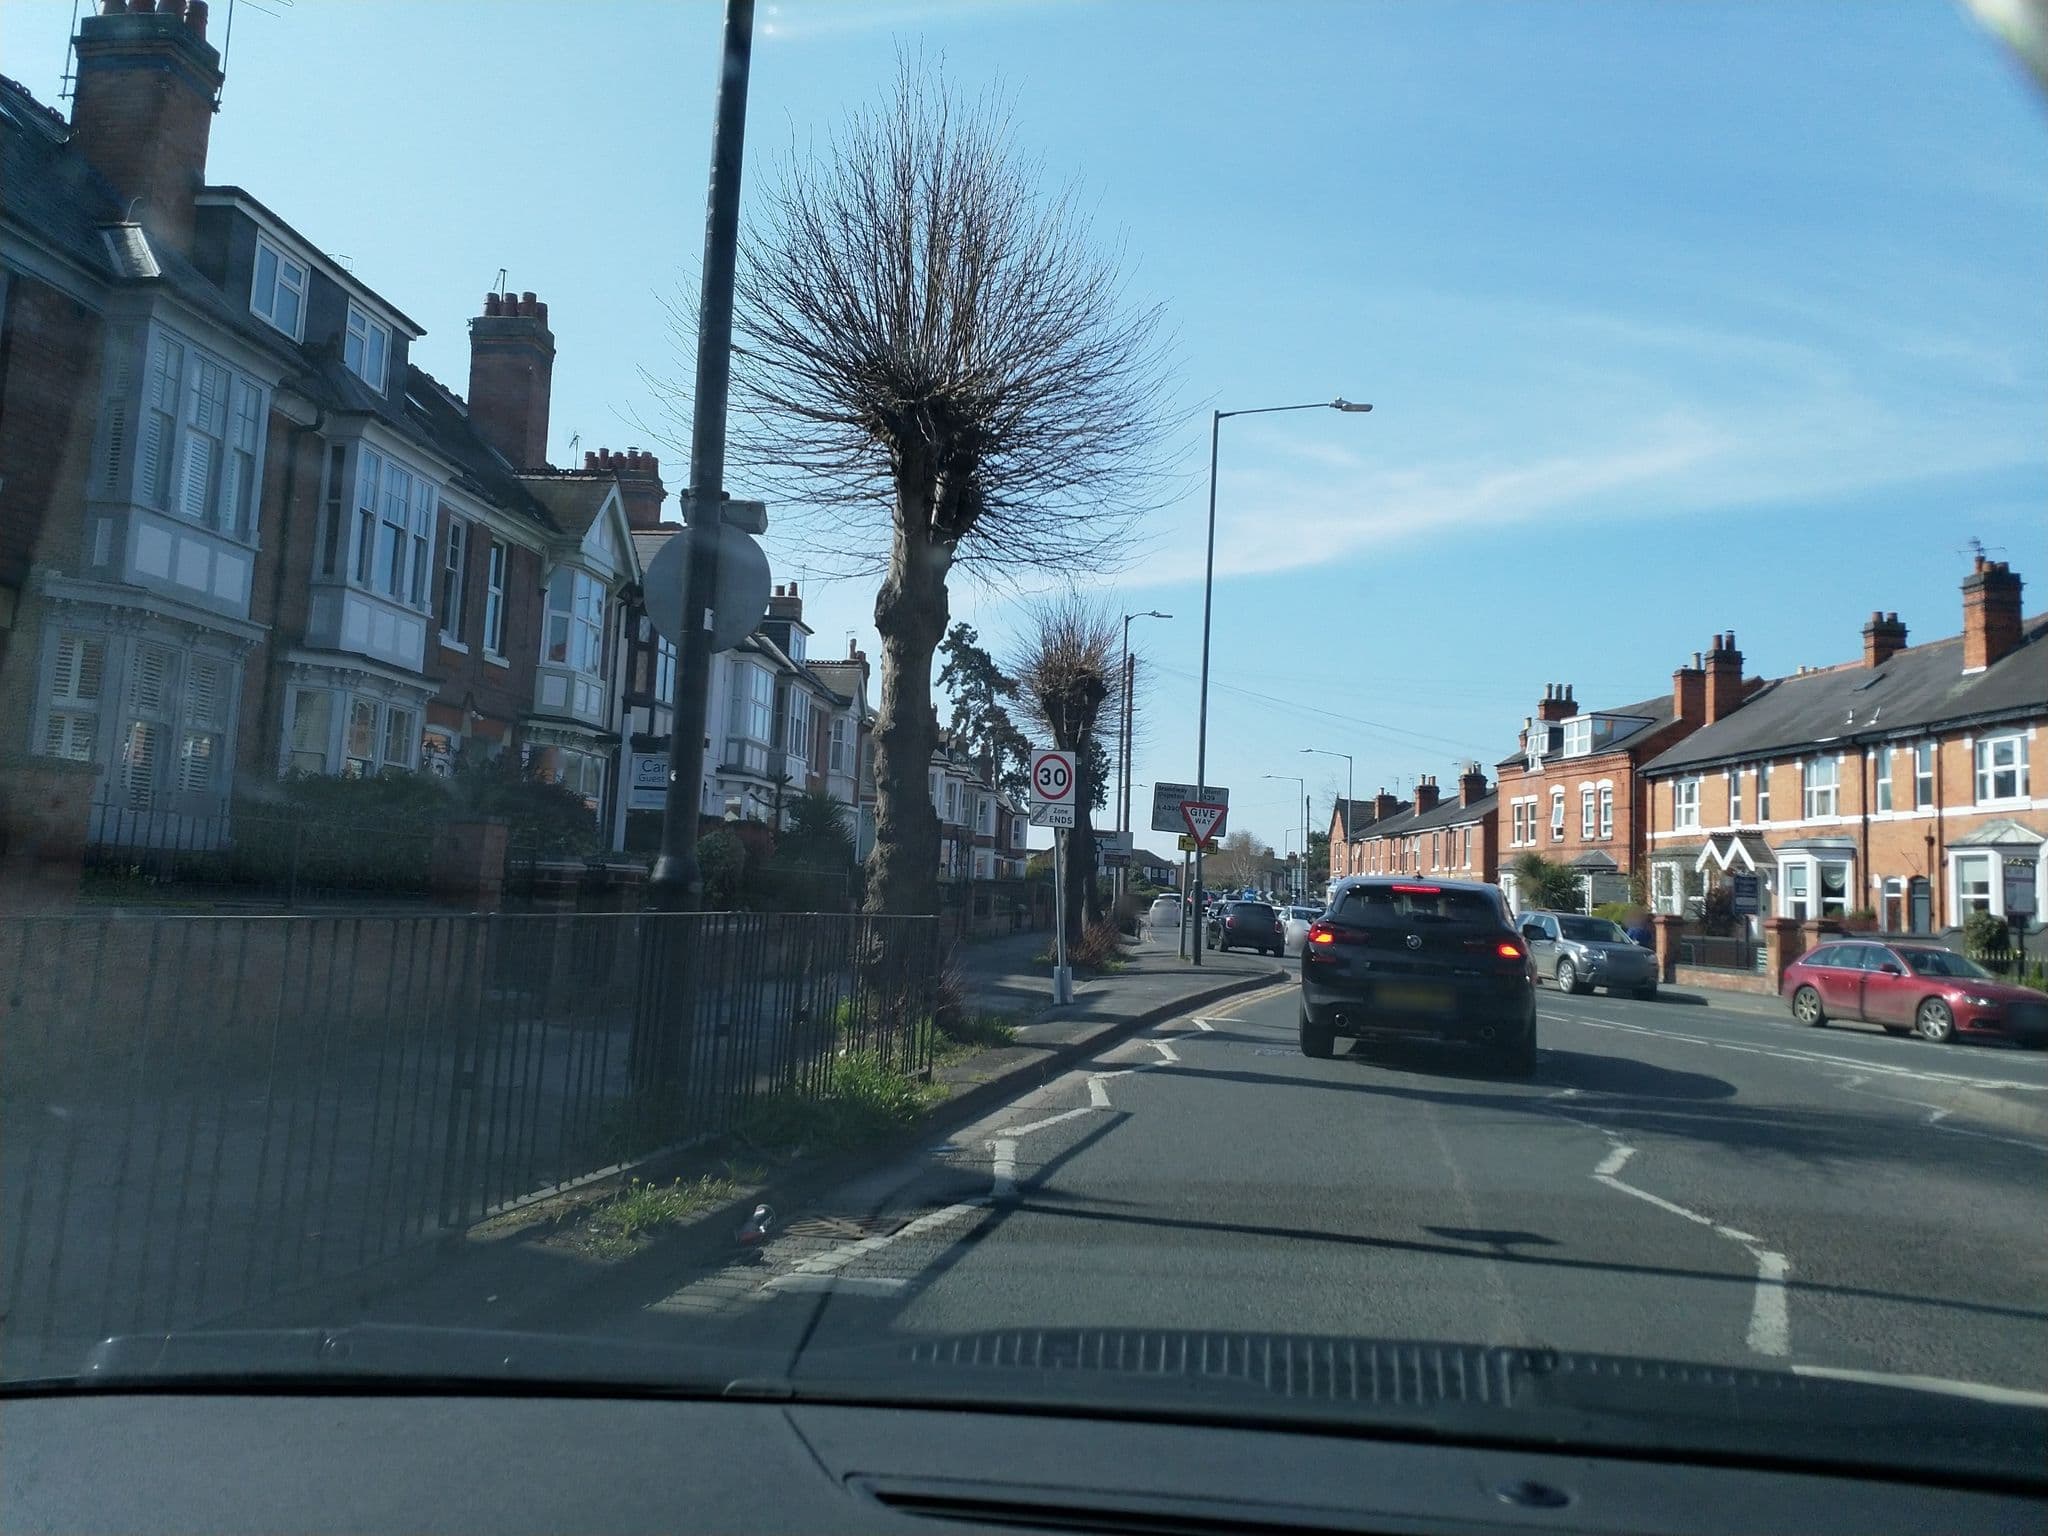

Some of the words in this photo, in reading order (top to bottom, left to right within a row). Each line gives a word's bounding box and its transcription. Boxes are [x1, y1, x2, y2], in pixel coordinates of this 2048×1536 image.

[1039, 767, 1067, 787] 30
[1053, 807, 1069, 815] Zone
[1190, 807, 1216, 819] GIVE
[1049, 815, 1073, 825] ENDS
[1194, 818, 1212, 826] WAY
